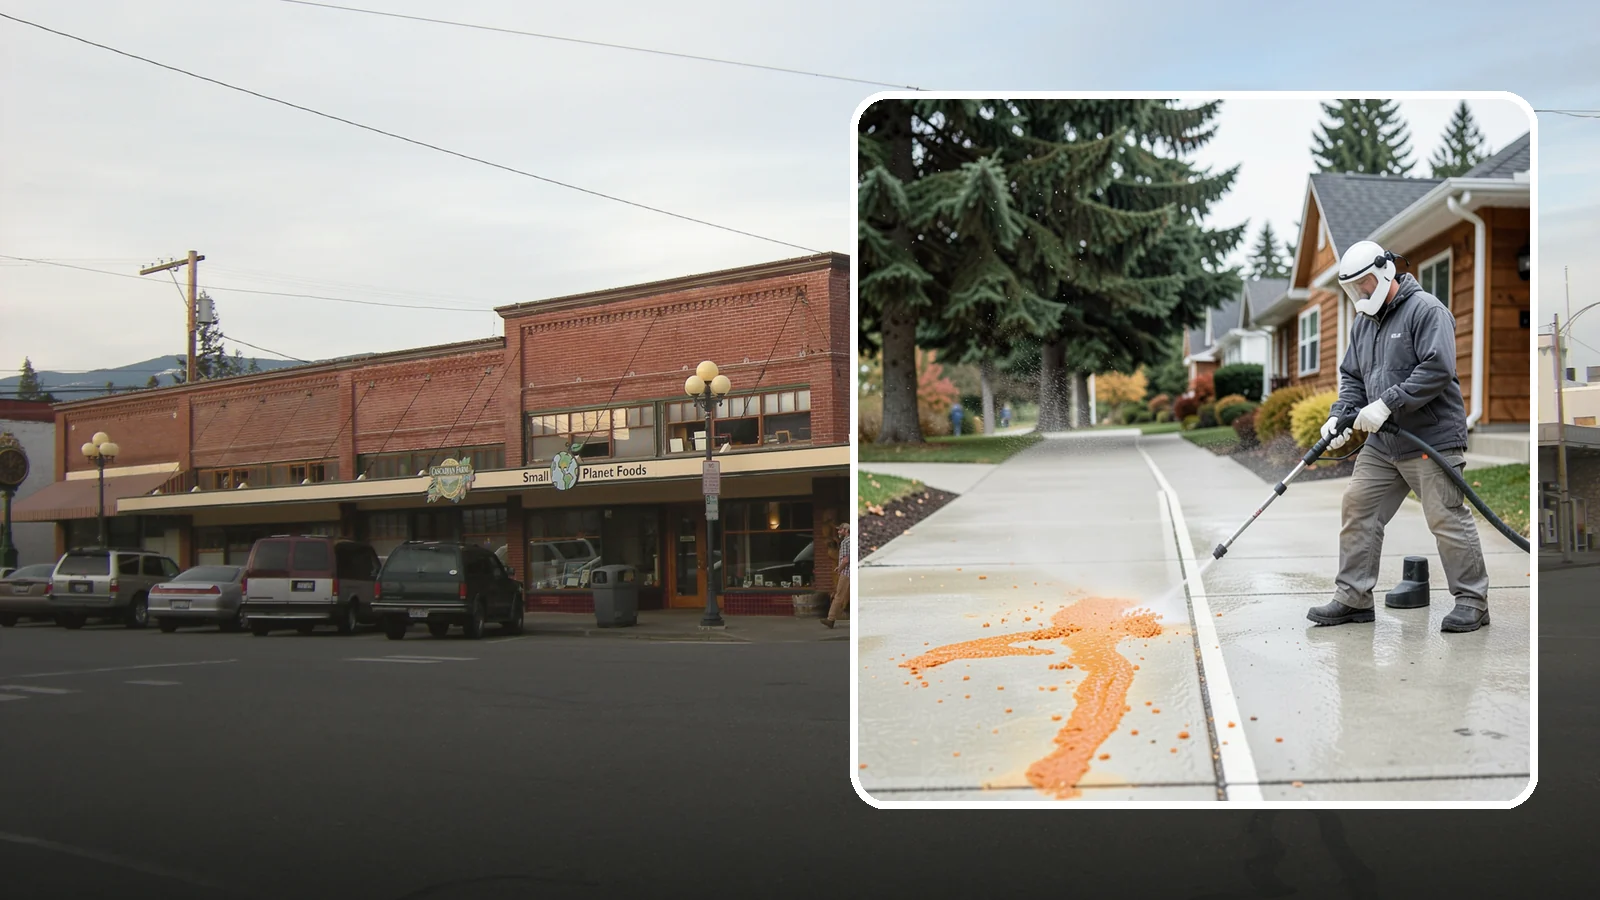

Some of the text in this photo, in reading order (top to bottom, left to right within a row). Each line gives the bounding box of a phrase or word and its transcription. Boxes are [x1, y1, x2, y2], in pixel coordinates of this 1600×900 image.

[523, 464, 647, 483] Small Planet Foods
